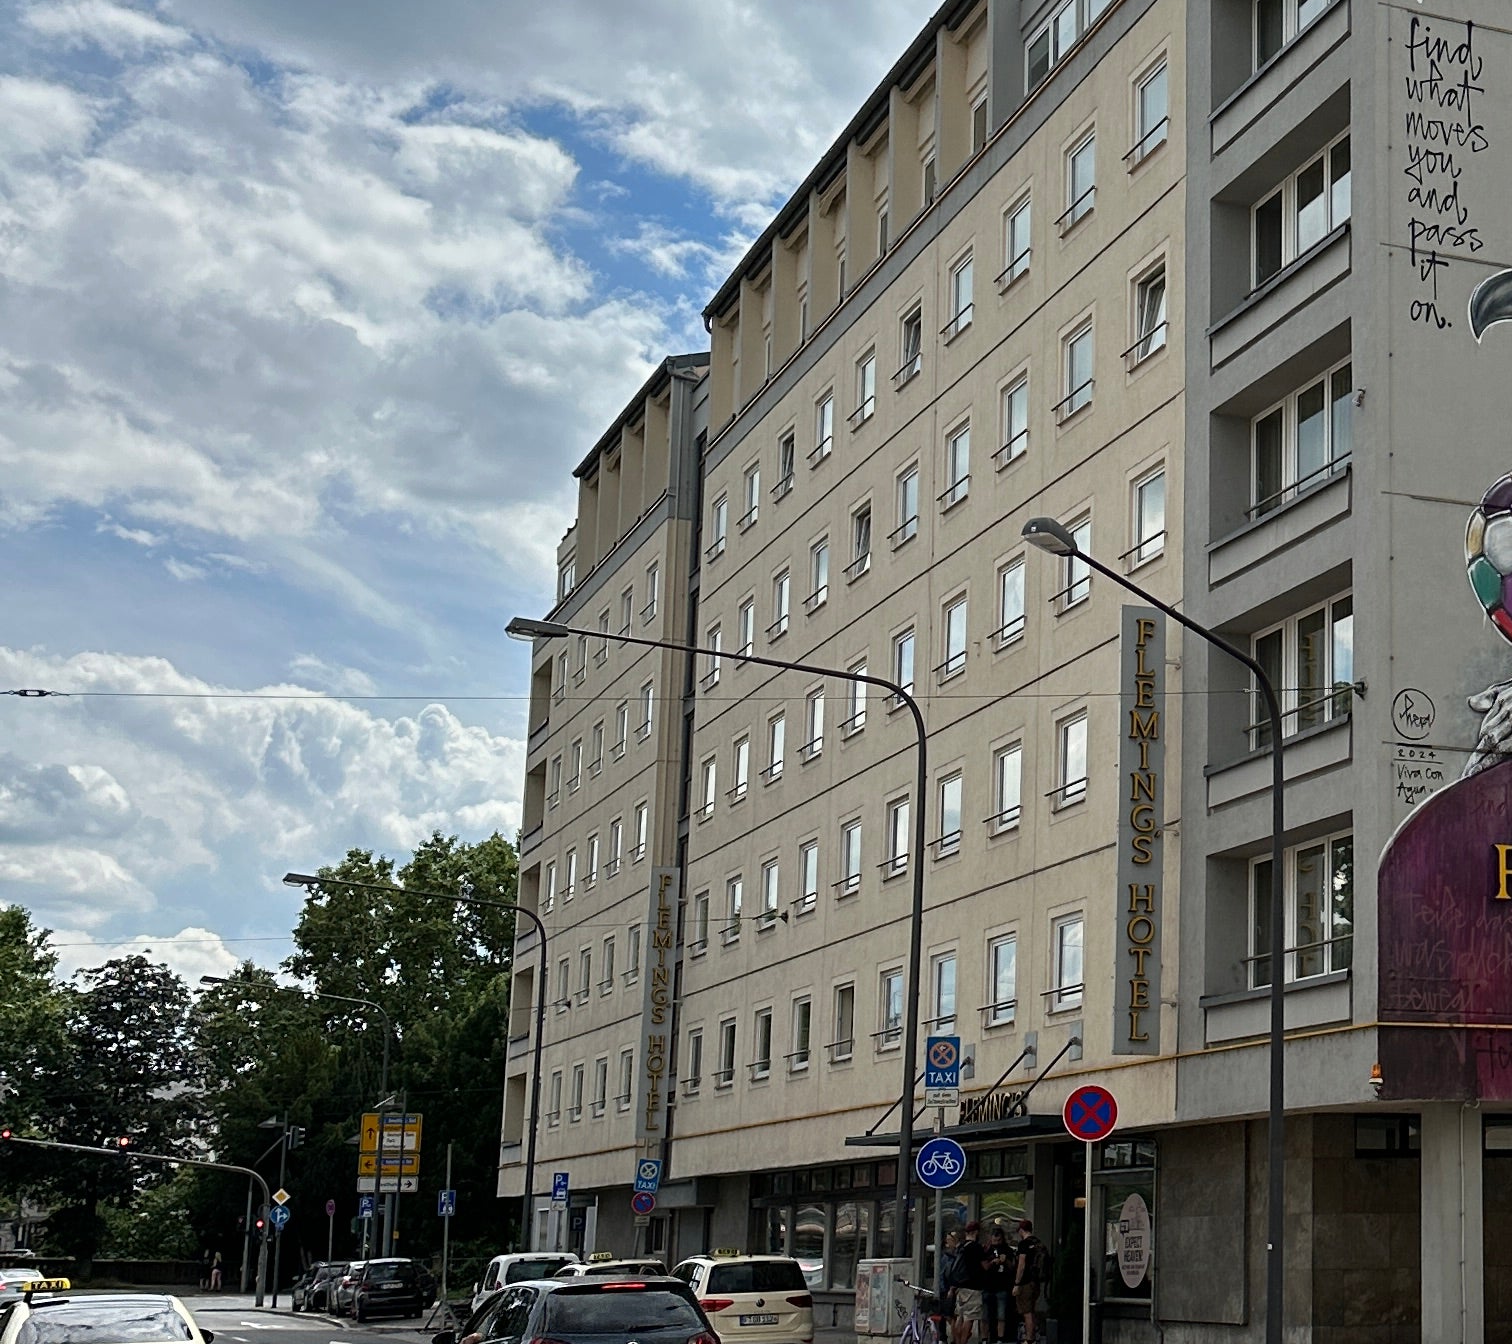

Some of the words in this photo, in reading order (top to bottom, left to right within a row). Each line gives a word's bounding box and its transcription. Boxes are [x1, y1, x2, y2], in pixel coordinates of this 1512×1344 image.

[1405, 16, 1482, 81] find
[1406, 60, 1484, 126] what
[1405, 110, 1489, 152] moves
[1405, 142, 1462, 184] you
[1407, 181, 1467, 224] and
[1408, 216, 1484, 266] pass
[1419, 250, 1449, 300] it
[1410, 298, 1452, 329] on.
[1396, 763, 1422, 781] Viva
[1397, 748, 1437, 759] 2024
[1127, 882, 1155, 1042] HOTEL
[645, 1034, 665, 1131] HOTEL
[928, 1071, 957, 1084] TAXI
[636, 1180, 656, 1190] TAXI
[32, 1280, 63, 1291] TAXI
